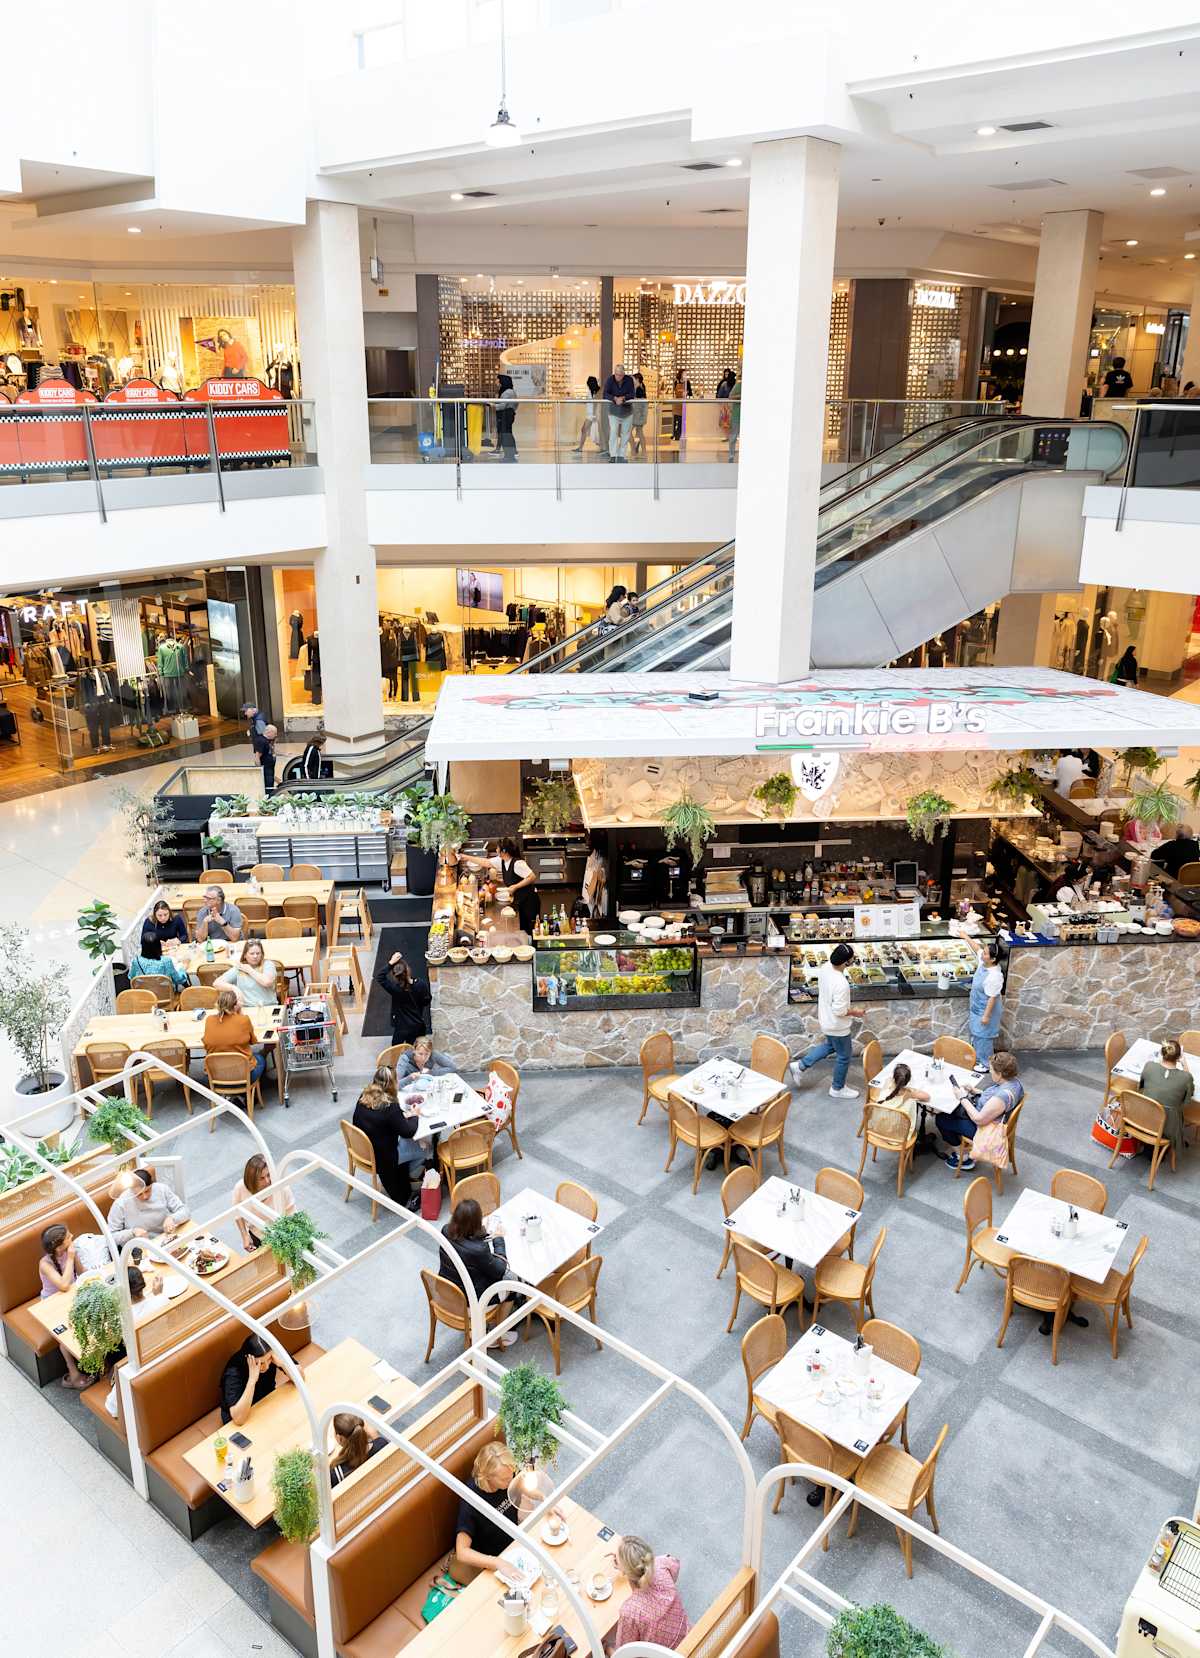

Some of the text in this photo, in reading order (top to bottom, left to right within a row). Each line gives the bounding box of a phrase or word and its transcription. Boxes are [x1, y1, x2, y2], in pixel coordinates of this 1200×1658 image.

[209, 383, 258, 395] KIDDY CARS
[16, 599, 88, 623] RAFT
[755, 701, 987, 737] Frankie B's
